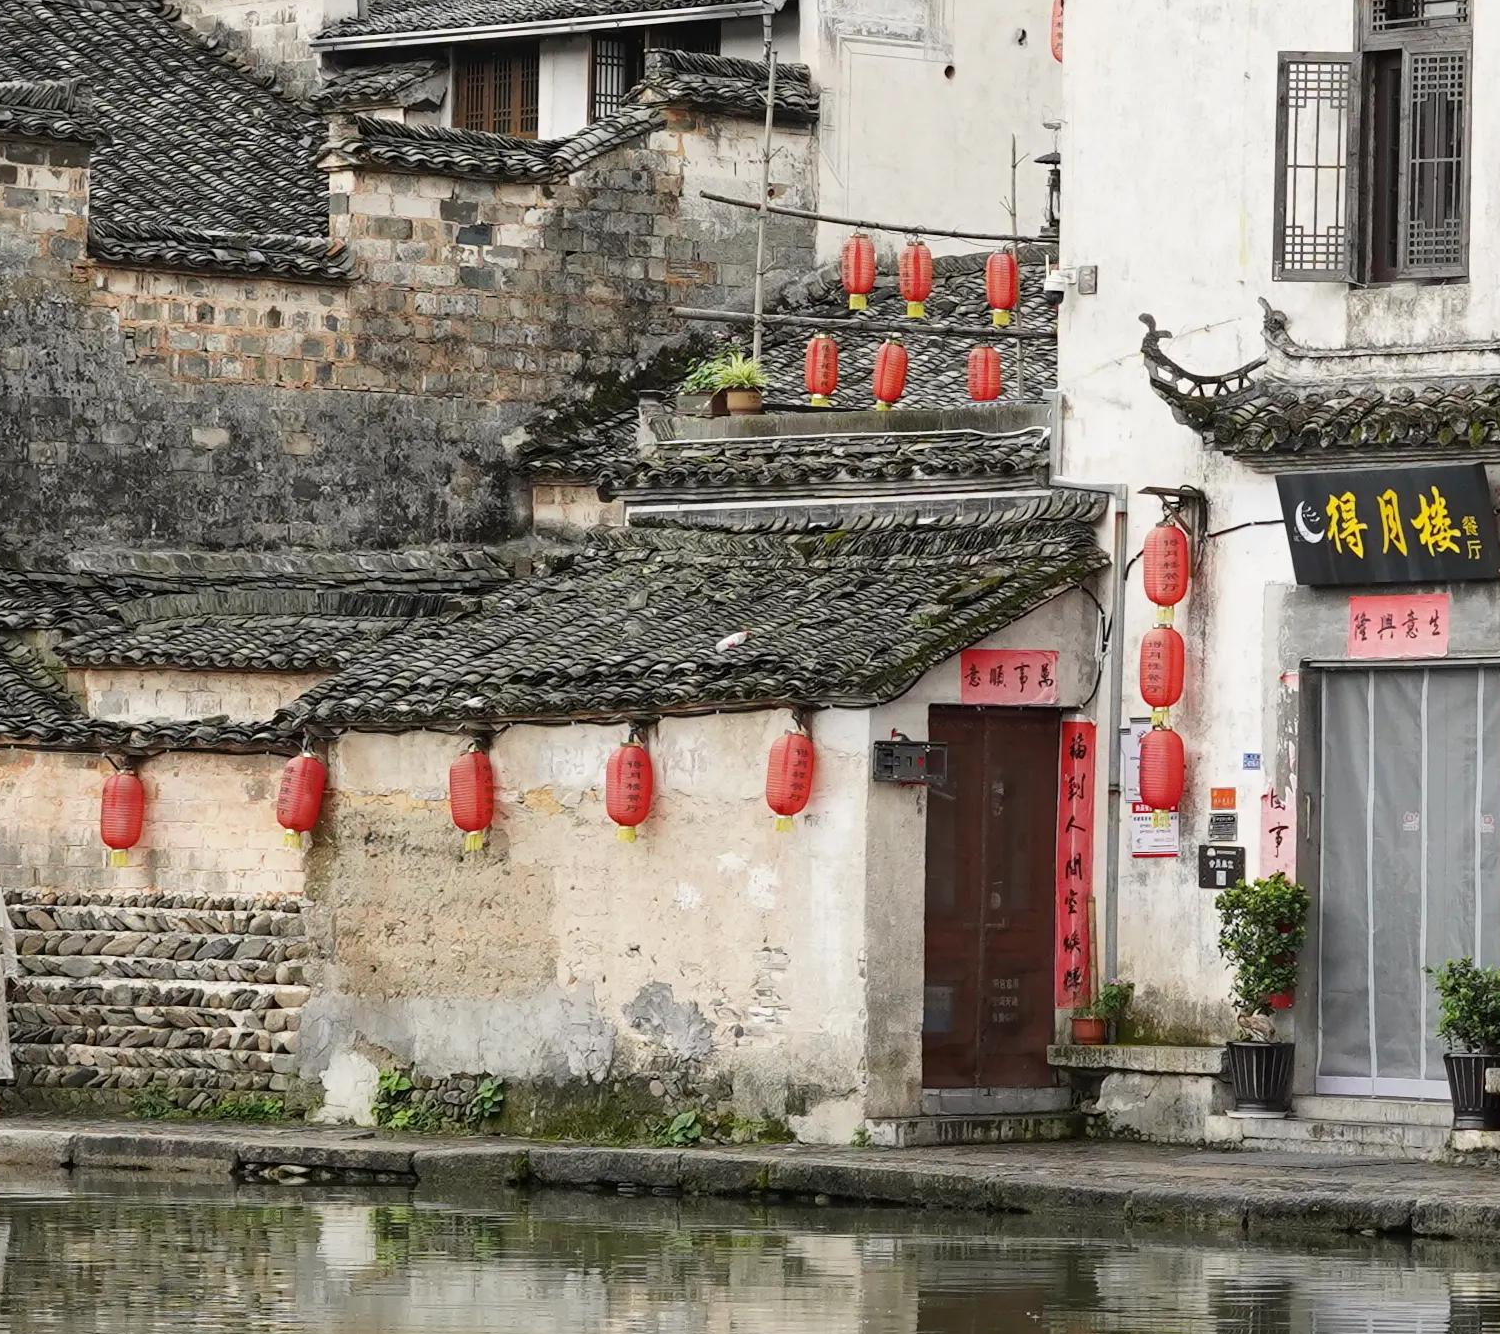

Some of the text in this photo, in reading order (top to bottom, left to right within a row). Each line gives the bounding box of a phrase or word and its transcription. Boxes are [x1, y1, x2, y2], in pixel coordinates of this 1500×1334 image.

[1325, 485, 1461, 559] 得月楼
[1461, 515, 1483, 560] 餐厅
